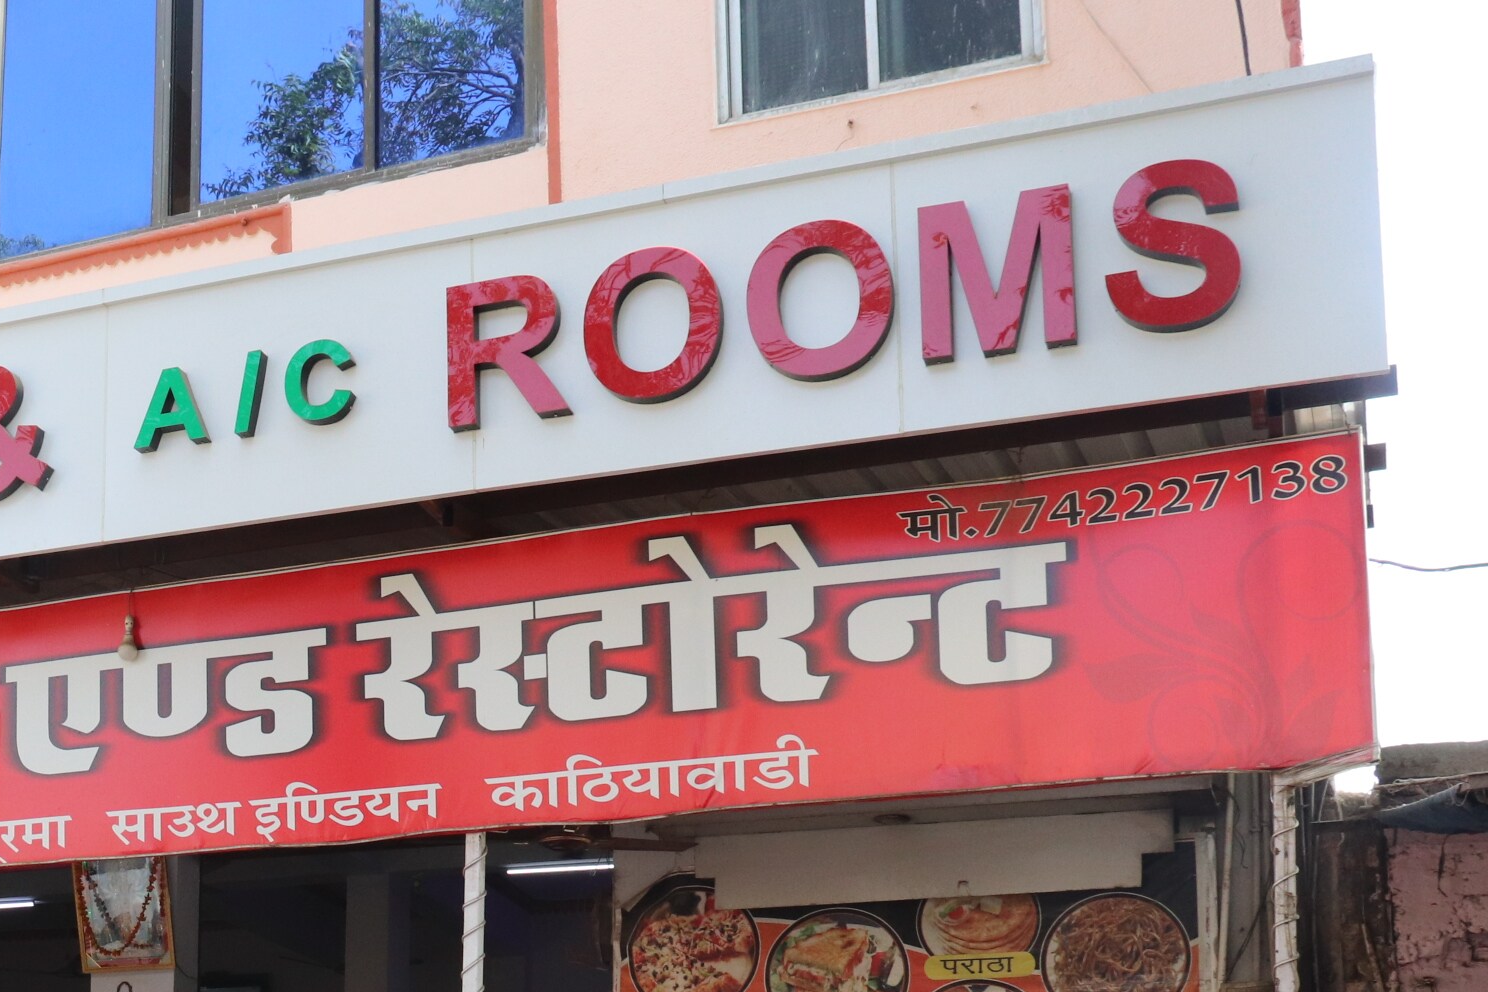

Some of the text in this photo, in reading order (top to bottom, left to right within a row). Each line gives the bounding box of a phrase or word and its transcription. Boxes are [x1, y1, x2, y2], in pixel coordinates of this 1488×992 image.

[446, 159, 1242, 434] ROOMS
[6, 627, 327, 776] एण्ड
[356, 523, 1067, 741] रेस्टोरेन्ट
[106, 800, 243, 846] साउथ
[248, 782, 444, 843] इण्डियन
[940, 956, 1014, 974] पराठा
